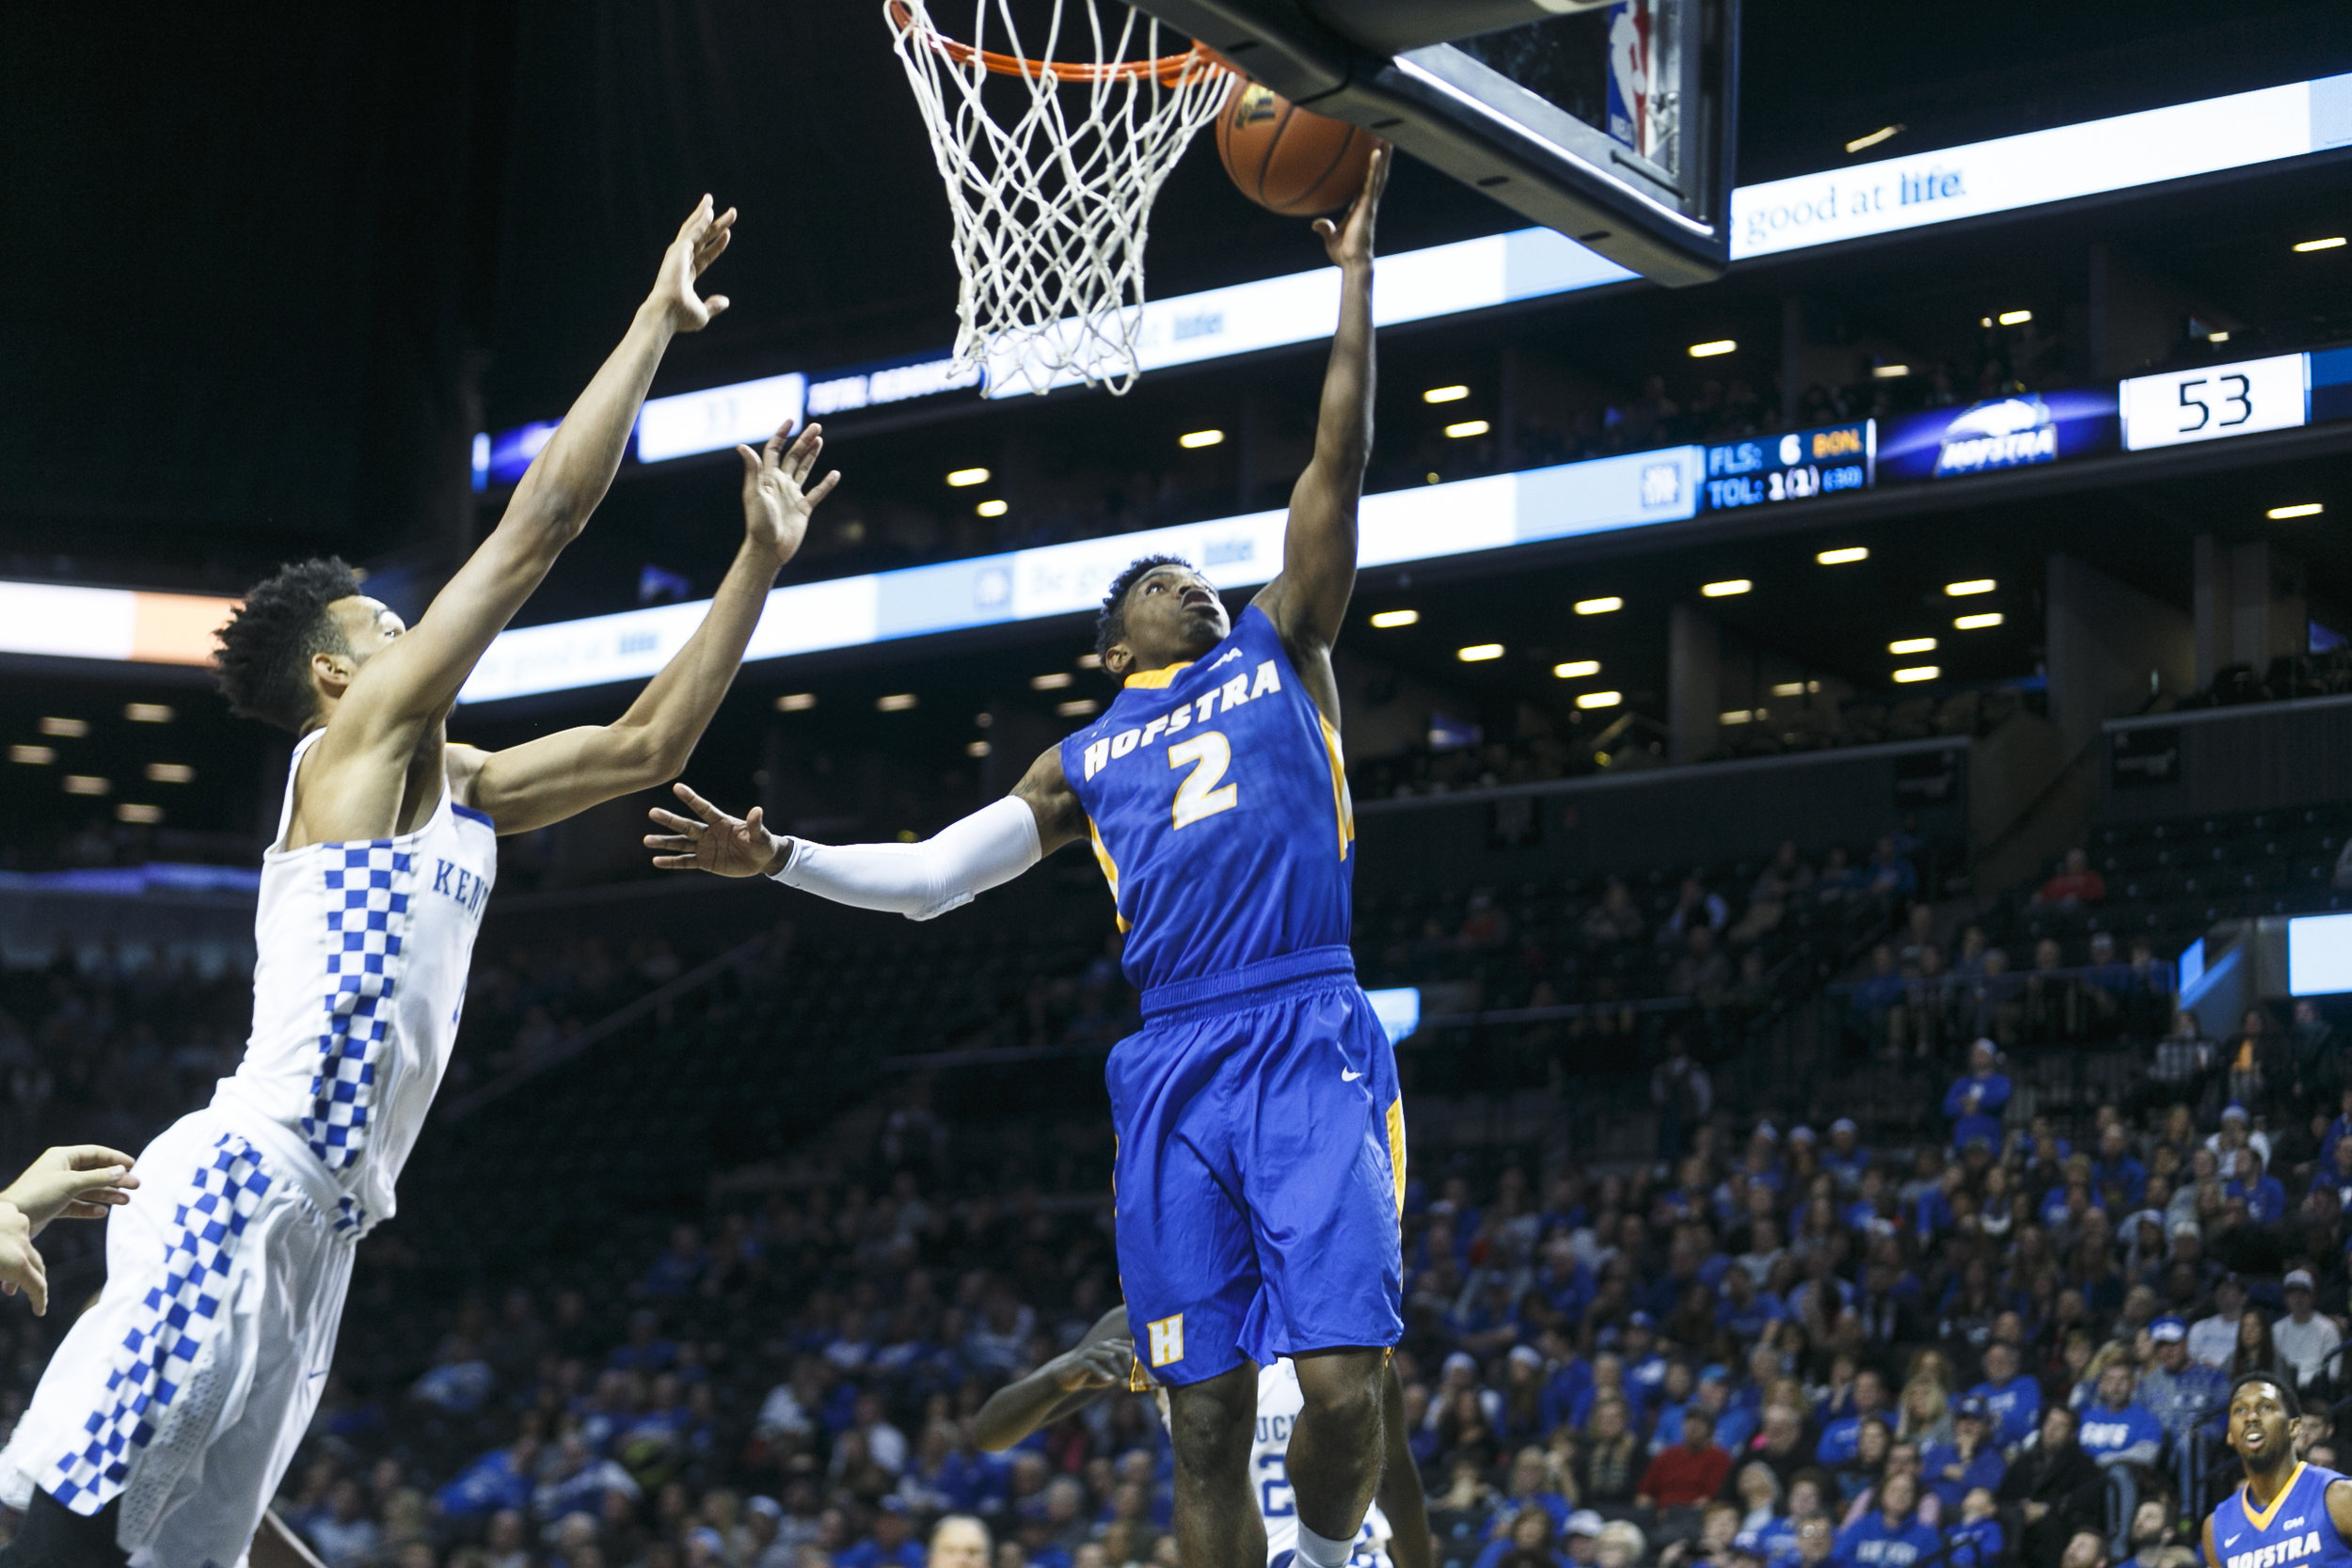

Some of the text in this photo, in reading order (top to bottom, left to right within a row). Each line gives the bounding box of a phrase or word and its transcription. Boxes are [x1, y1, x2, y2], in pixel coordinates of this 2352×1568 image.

[1747, 186, 1836, 245] good
[1851, 186, 1883, 214] at
[2179, 374, 2252, 433] 53
[1708, 442, 1762, 477] FLS:
[1779, 434, 1802, 466] 6
[1707, 476, 1764, 510] TOL:
[1084, 658, 1281, 783] HOFSTRA
[1168, 731, 1238, 831] 2
[1147, 1313, 1184, 1368] H
[2227, 1530, 2322, 1568] HOFSTRA
